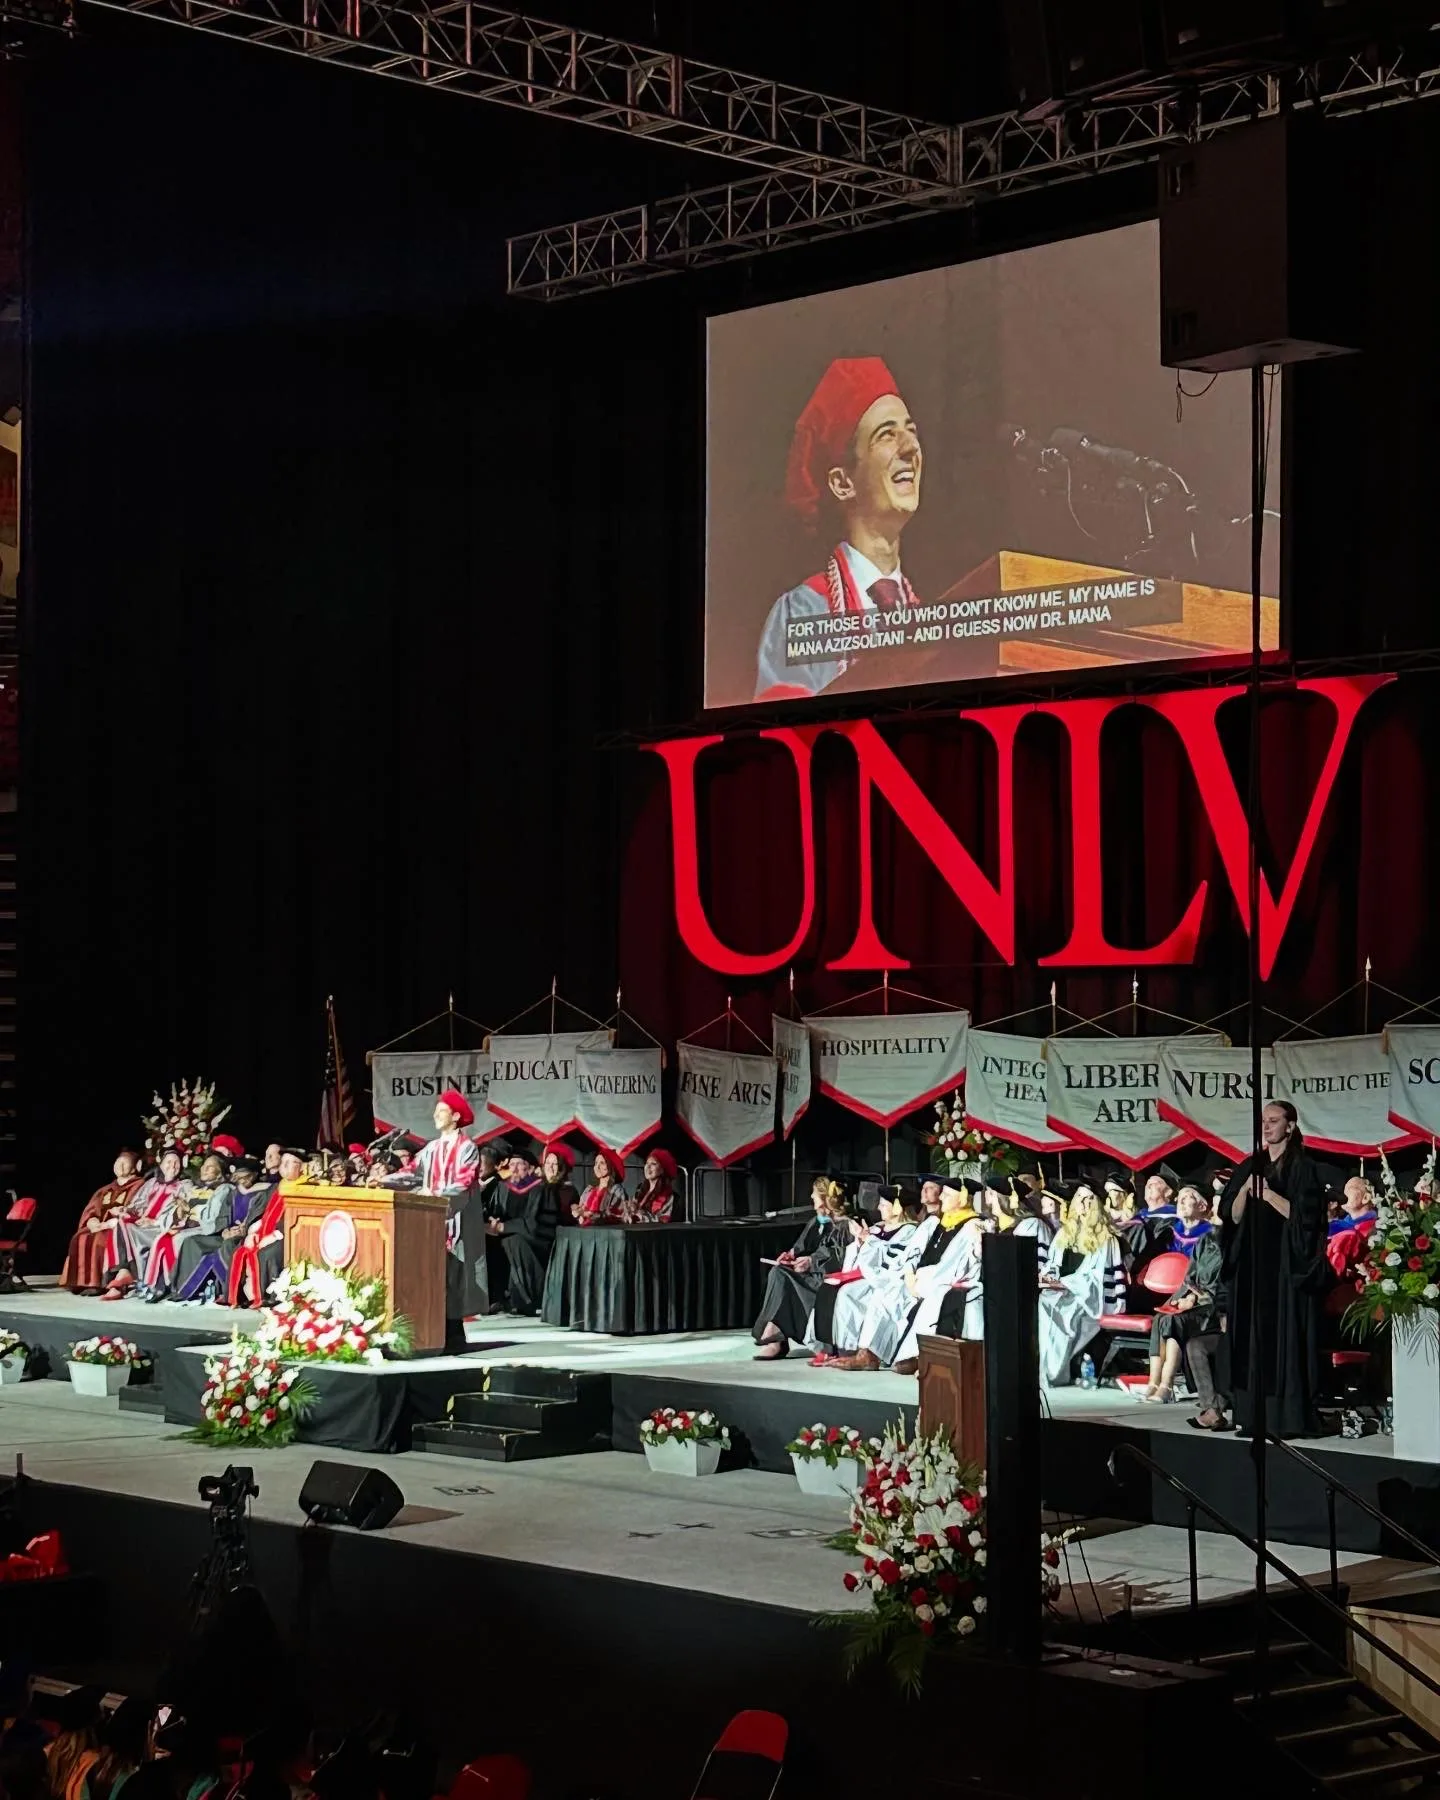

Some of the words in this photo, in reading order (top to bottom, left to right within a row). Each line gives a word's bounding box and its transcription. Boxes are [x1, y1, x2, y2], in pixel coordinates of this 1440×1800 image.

[787, 621, 814, 638] FOR
[816, 615, 860, 635] THOSE
[862, 613, 881, 629] OF
[883, 609, 912, 627] YOU
[914, 605, 948, 623] WHO
[950, 598, 992, 618] DON'T
[993, 592, 1038, 613] KNOW
[1069, 585, 1092, 604] MY
[1094, 581, 1138, 602] NAME
[1140, 579, 1156, 596] IS
[787, 639, 825, 658] MANA
[824, 629, 905, 652] AZIZSOLTANI
[913, 625, 943, 643] AND
[945, 624, 950, 639] I
[952, 618, 1001, 638] GUESS
[1003, 614, 1038, 633] NOW
[1040, 611, 1066, 628] DR.
[1068, 605, 1112, 625] MANA
[638, 672, 1398, 982] UNLV
[821, 1036, 950, 1057] HOSPITALITY
[490, 1059, 573, 1081] EDUCAT
[982, 1055, 1046, 1080] INTEG
[1064, 1063, 1160, 1089] LIBER
[577, 1074, 657, 1095] ENGINEERING
[680, 1071, 722, 1099] FINE
[727, 1080, 772, 1106] ARTS
[1004, 1081, 1048, 1103] HEA
[1291, 1074, 1360, 1094] PUBLIC
[1092, 1097, 1165, 1123] ART
